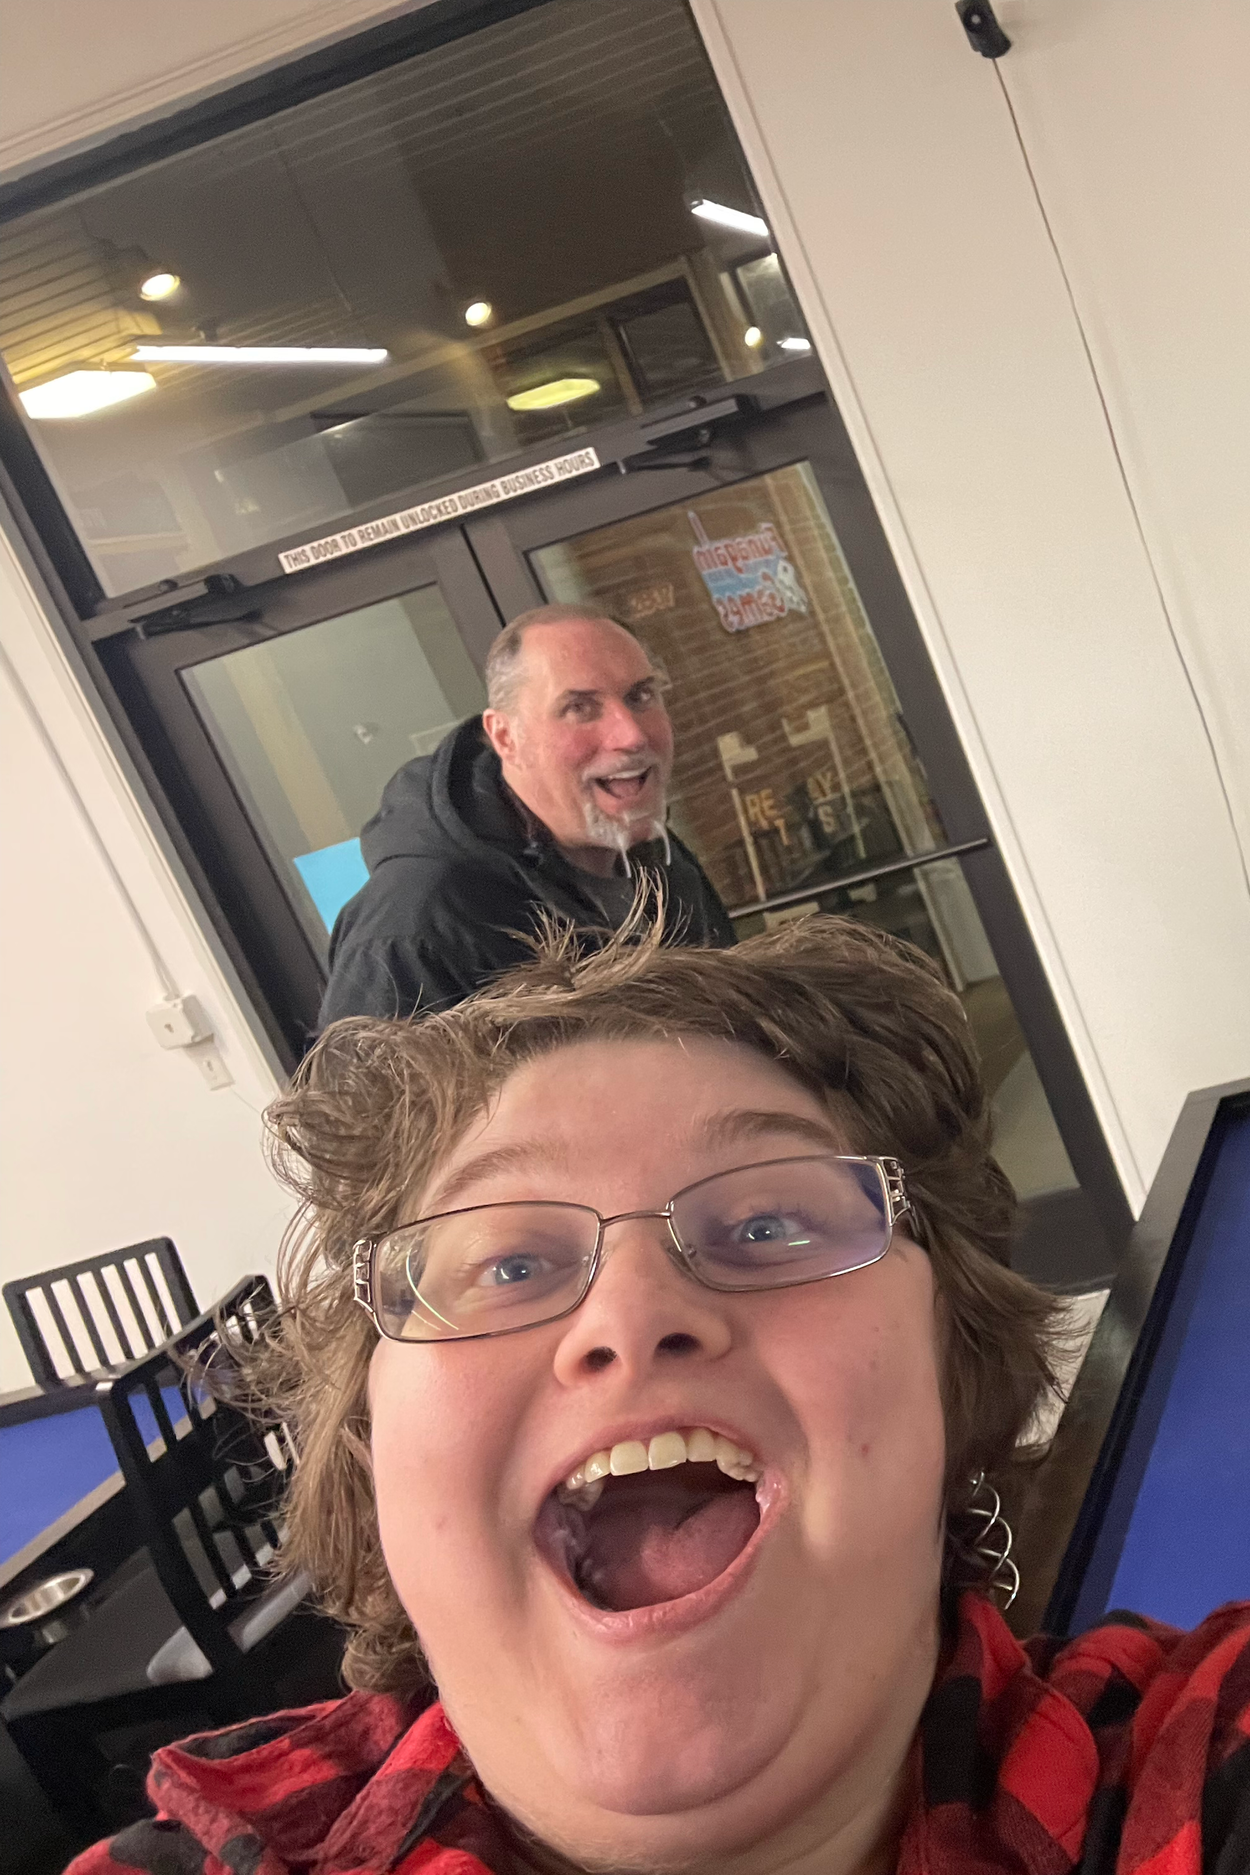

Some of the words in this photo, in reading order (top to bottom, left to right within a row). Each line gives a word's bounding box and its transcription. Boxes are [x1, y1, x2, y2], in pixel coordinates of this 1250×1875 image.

[284, 549, 310, 569] THIS
[310, 539, 342, 560] DOOR
[340, 532, 358, 549] TO
[357, 518, 401, 544] REMAIN
[400, 501, 459, 529] UNLOCKED
[457, 484, 501, 510] DURING
[500, 465, 555, 496] BUSINESS
[554, 451, 595, 477] HOURS
